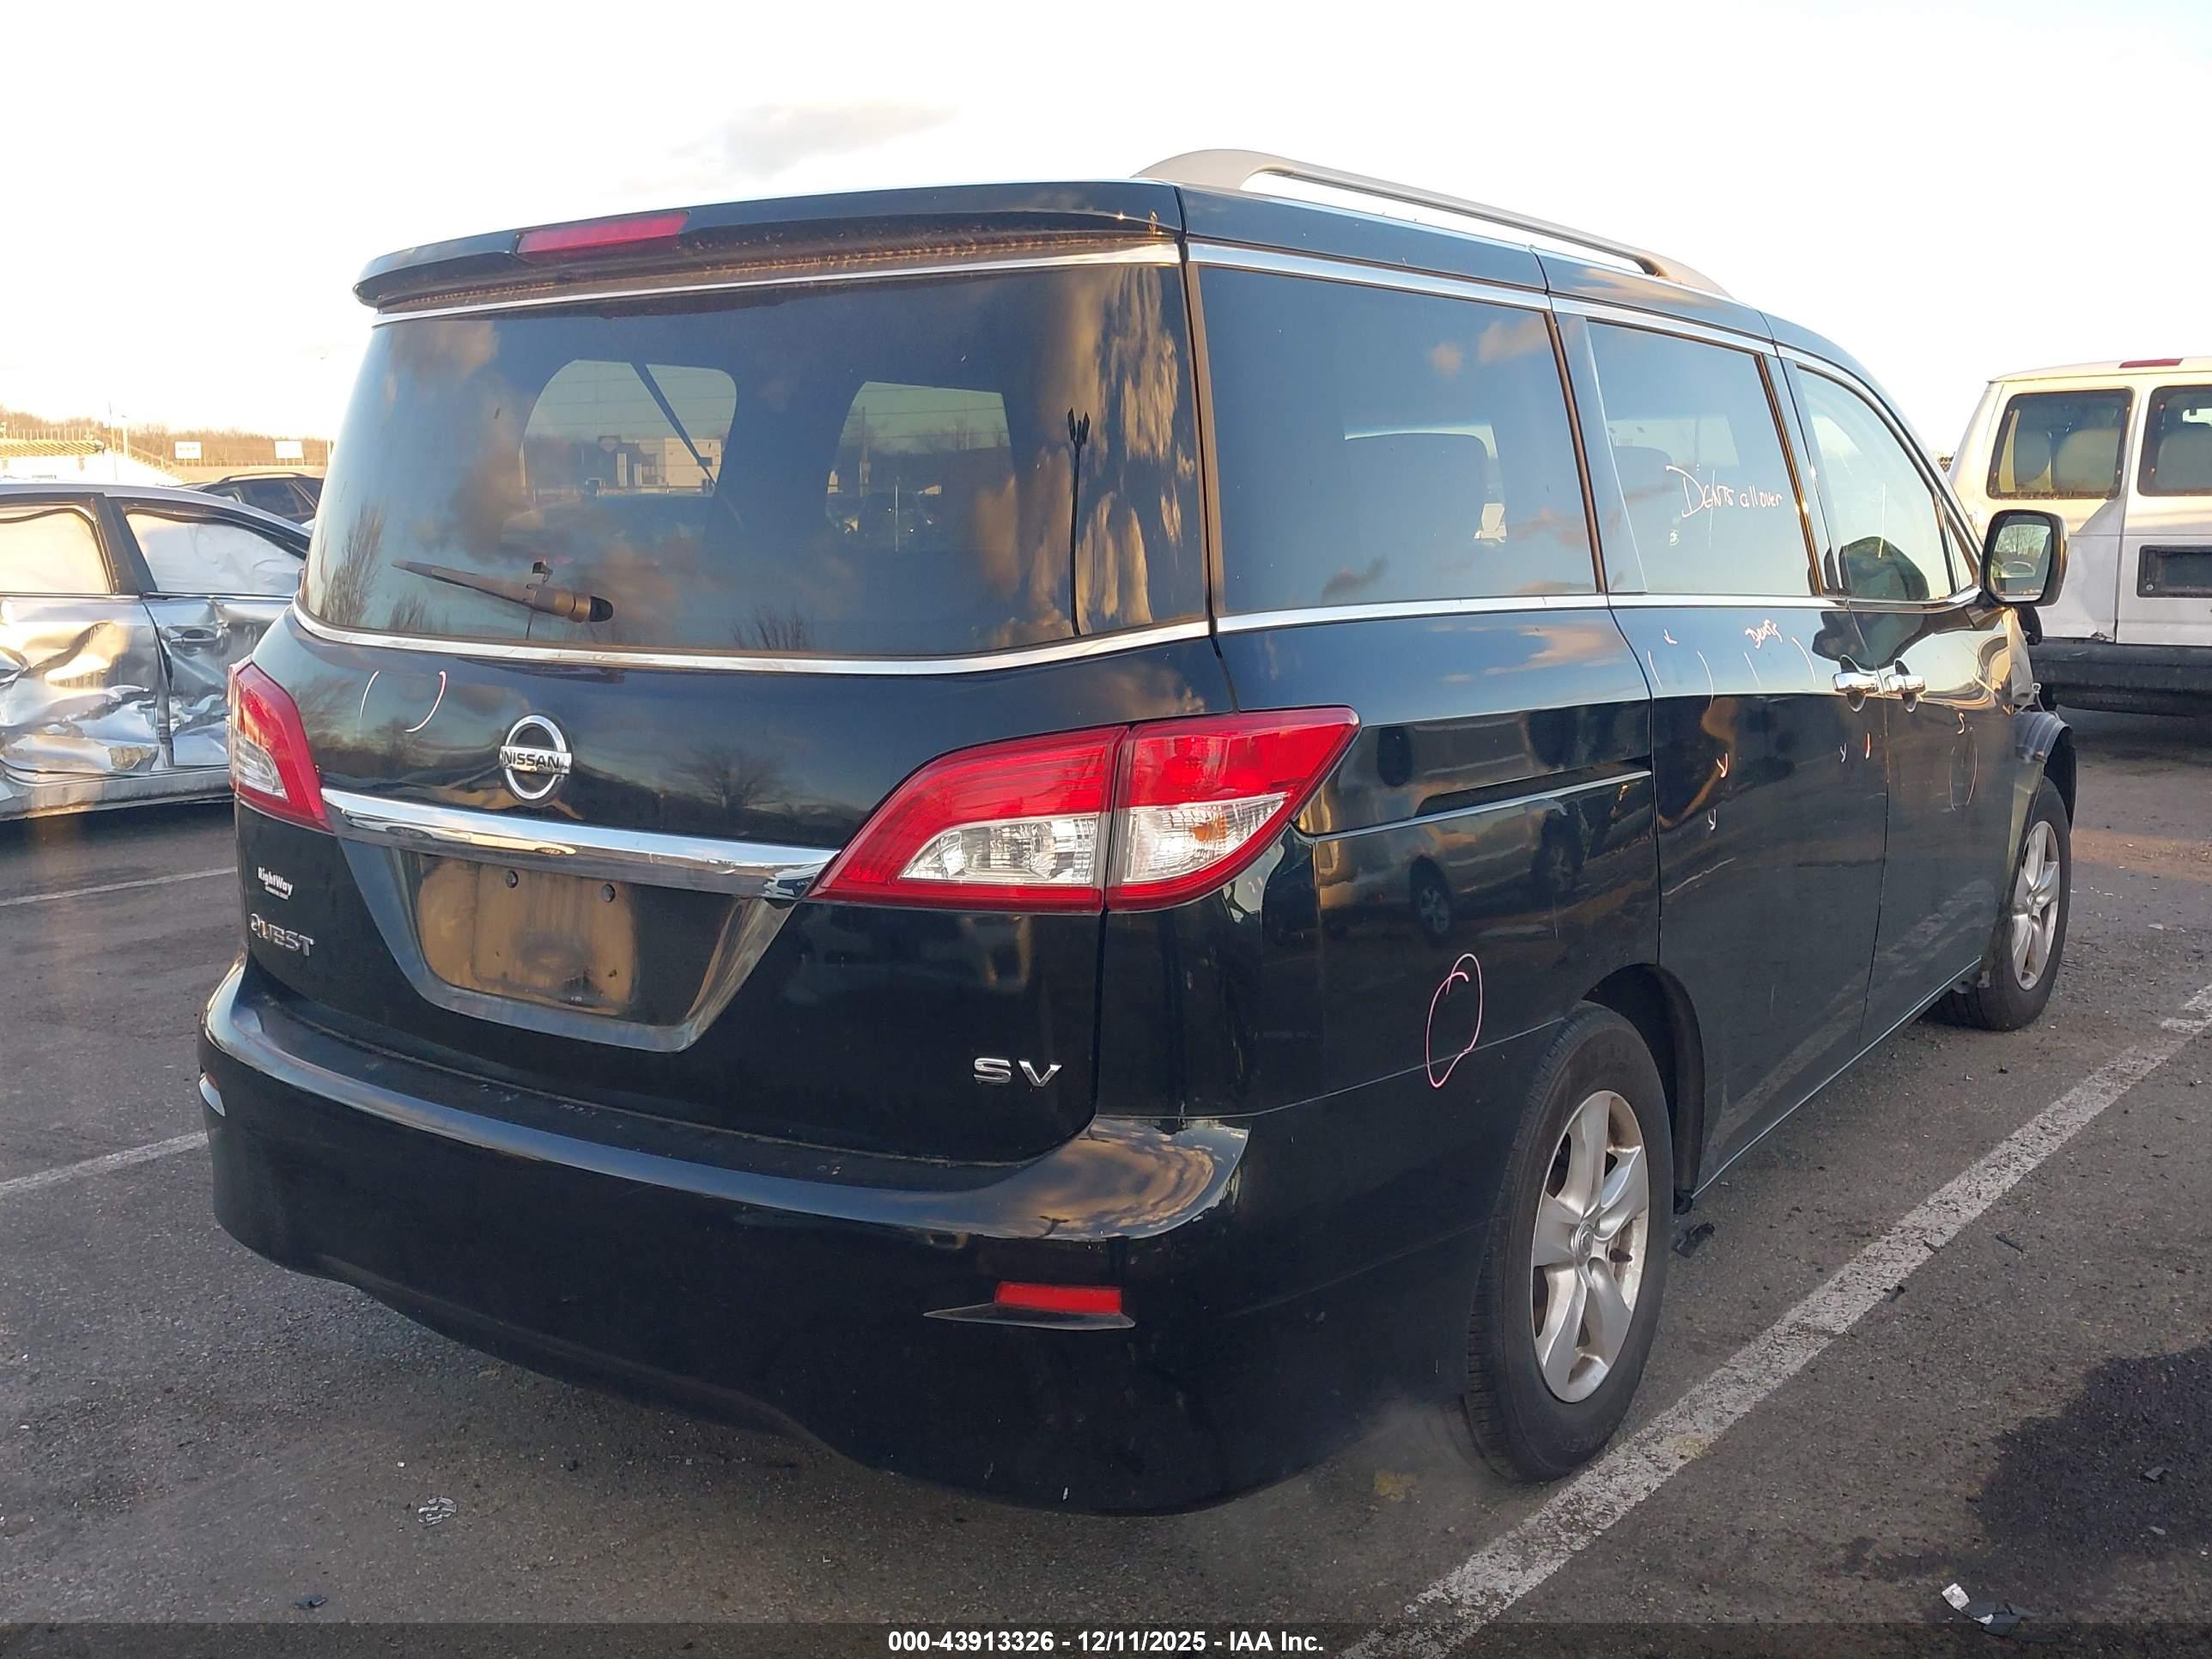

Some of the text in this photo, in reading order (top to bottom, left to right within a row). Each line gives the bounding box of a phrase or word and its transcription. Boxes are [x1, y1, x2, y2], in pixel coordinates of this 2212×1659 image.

[503, 752, 560, 769] NISSAN
[251, 913, 315, 957] QUEST
[973, 1057, 1062, 1088] SV
